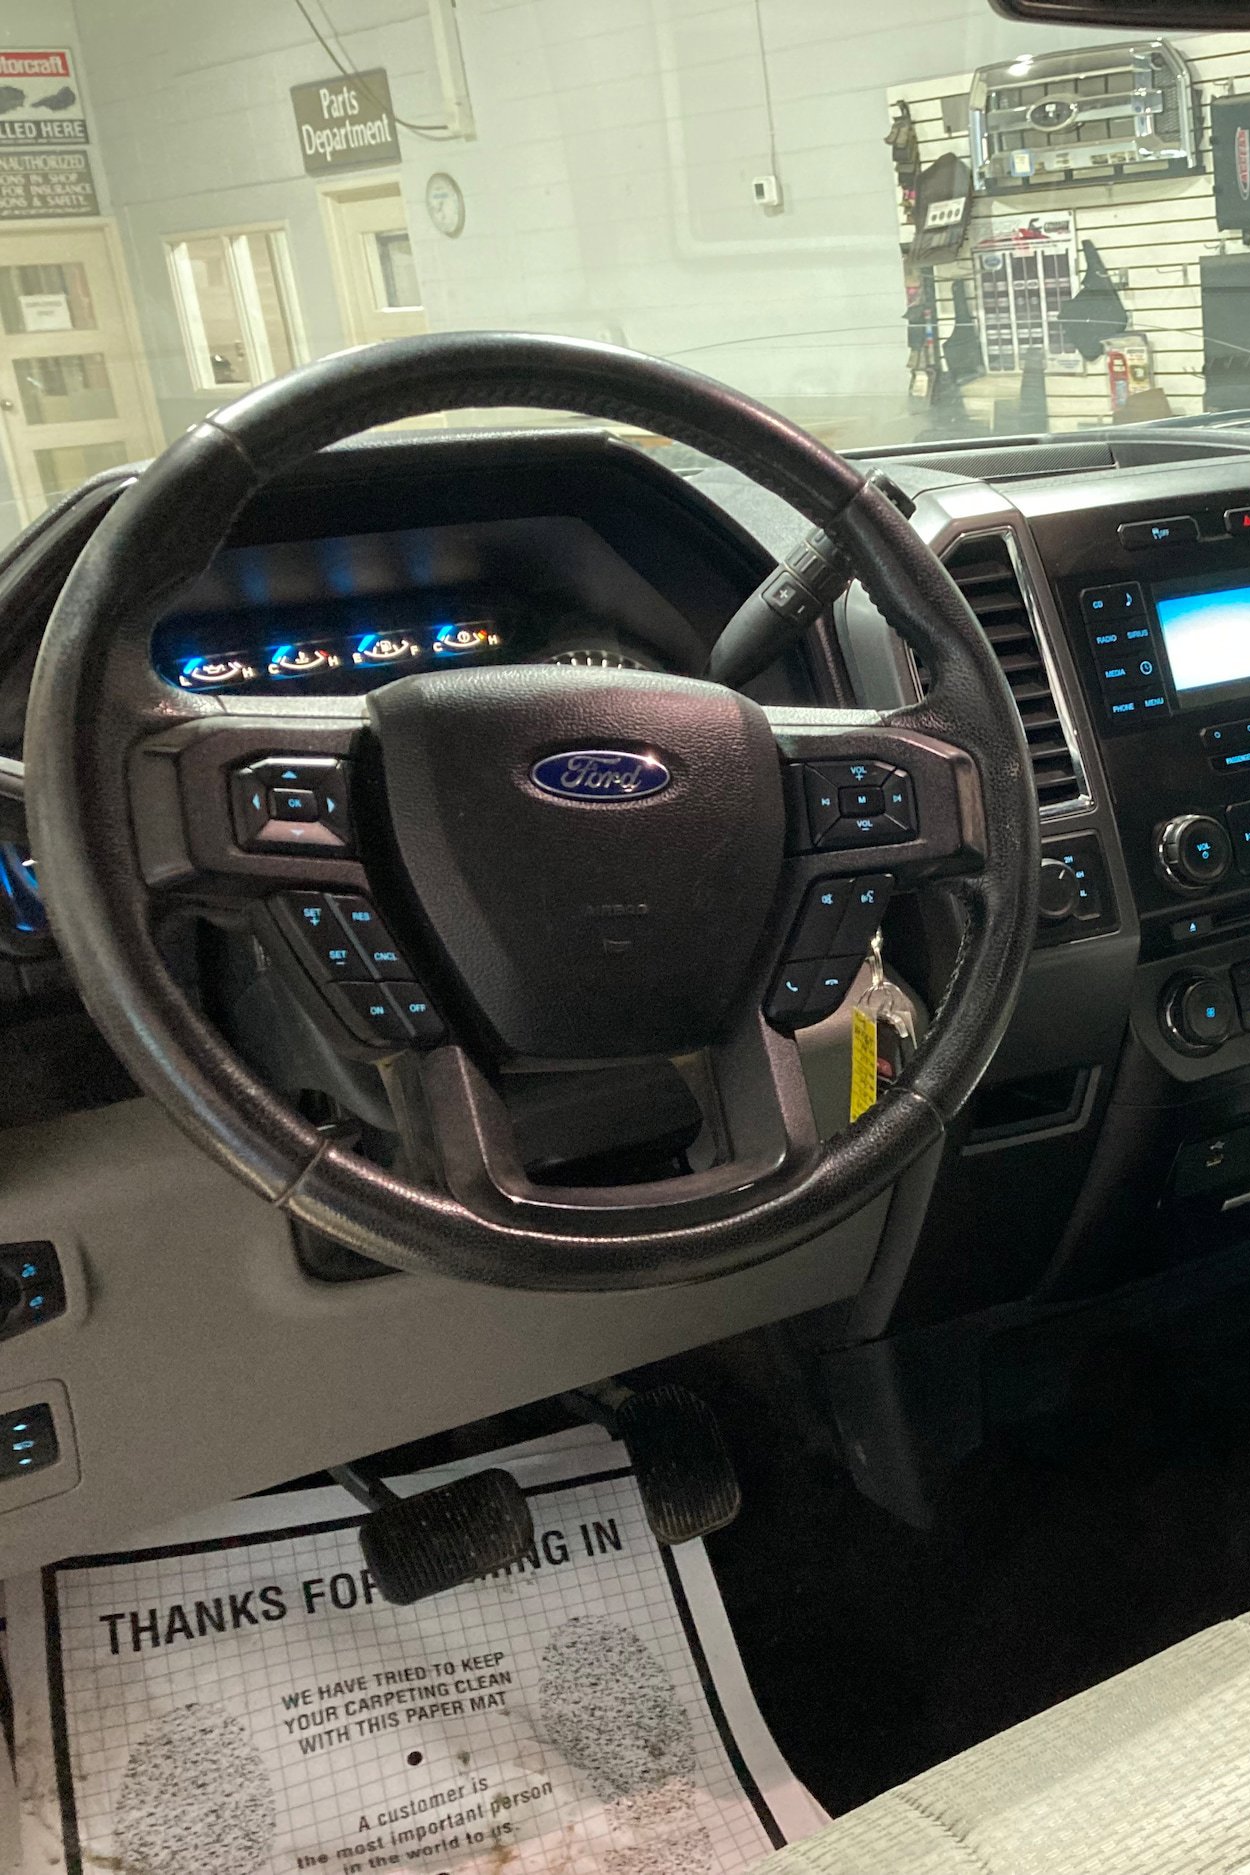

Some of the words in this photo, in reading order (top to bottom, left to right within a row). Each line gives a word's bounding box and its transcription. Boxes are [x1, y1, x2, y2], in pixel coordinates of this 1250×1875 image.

[319, 85, 359, 119] Parts
[41, 121, 85, 137] HERE
[301, 113, 392, 162] Department
[29, 173, 43, 184] IN
[48, 172, 78, 183] SHOP
[1, 185, 25, 196] FOR
[30, 183, 92, 195] INSURANCE
[1092, 600, 1104, 609] CD
[433, 641, 443, 652] C
[487, 635, 498, 645] H
[1096, 634, 1118, 645] RADIO
[1126, 628, 1149, 639] SIRIUS
[352, 653, 363, 663] E
[410, 645, 419, 656] F
[267, 663, 280, 675] C
[327, 655, 339, 667] H
[1105, 668, 1126, 678] MEDIA
[178, 675, 193, 687] L
[241, 667, 255, 678] H
[1112, 702, 1135, 713] PHONE
[1144, 697, 1165, 707] MENU
[560, 755, 643, 792] Ford
[850, 765, 867, 775] VOL
[287, 798, 302, 808] OK
[857, 796, 867, 804] M
[856, 819, 873, 829] VOL
[1196, 842, 1211, 852] VOL
[303, 908, 322, 917] SET
[352, 911, 371, 921] RES
[329, 950, 348, 960] SET
[373, 951, 398, 961] CNCL
[369, 1006, 384, 1015] ON
[409, 1003, 427, 1013] OFF
[579, 1518, 622, 1557] IN
[99, 1586, 288, 1655] THANKS
[281, 1688, 314, 1711] WE
[317, 1675, 369, 1701] HAVE
[372, 1666, 427, 1688] TRIED
[432, 1661, 456, 1678] TO
[460, 1651, 506, 1674] KEEP
[282, 1705, 340, 1736] YOUR
[344, 1683, 450, 1718] CARPETING
[454, 1670, 513, 1694] CLEAN
[297, 1725, 351, 1756] WITH
[354, 1711, 400, 1738] THIS
[405, 1701, 466, 1724] PAPER
[469, 1690, 508, 1712] MAT
[357, 1815, 371, 1833] A
[376, 1784, 466, 1828] customer
[470, 1776, 490, 1795] is
[296, 1852, 330, 1870] the
[335, 1836, 385, 1860] most
[388, 1803, 486, 1847] important
[489, 1781, 554, 1819] person
[341, 1861, 363, 1875] in
[367, 1850, 401, 1870] the
[405, 1835, 461, 1861] world
[465, 1830, 486, 1846] to
